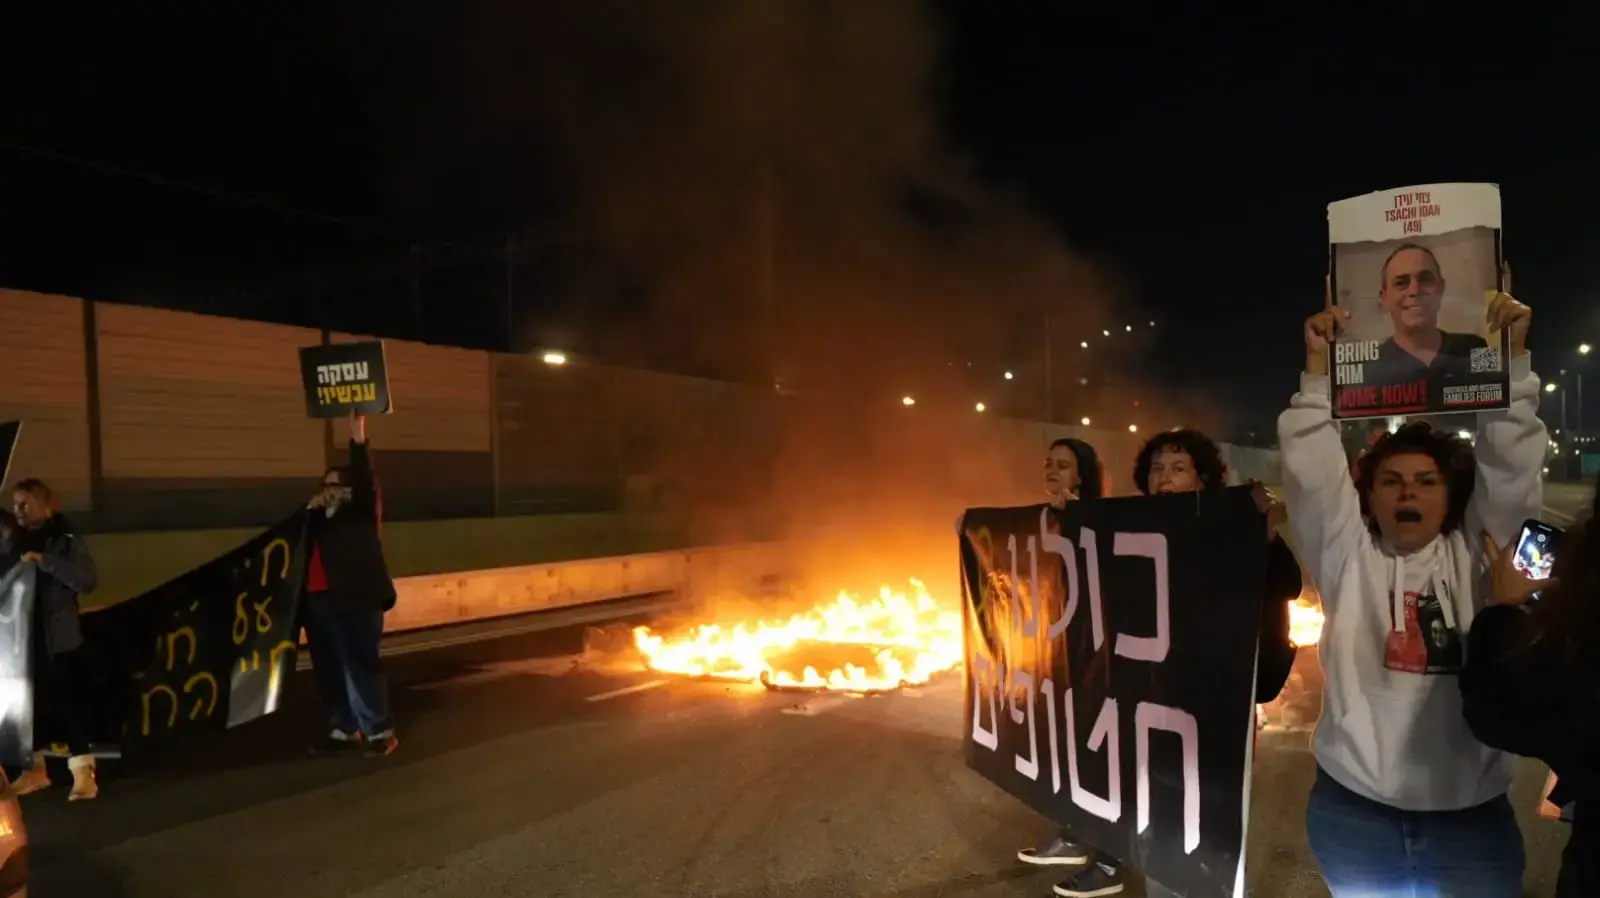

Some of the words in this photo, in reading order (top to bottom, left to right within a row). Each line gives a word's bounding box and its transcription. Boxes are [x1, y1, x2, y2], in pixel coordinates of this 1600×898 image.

[1385, 207, 1417, 222] TSACHI
[1403, 220, 1422, 234] (49)
[1335, 340, 1380, 364] BRING
[316, 361, 369, 386] עסקה
[1336, 363, 1364, 385] HIM
[318, 383, 377, 405] עכשיו!
[1337, 385, 1379, 409] HOME
[1476, 389, 1503, 402] FORUM
[1007, 507, 1171, 662] כולנו
[971, 652, 1201, 855] חטופים
